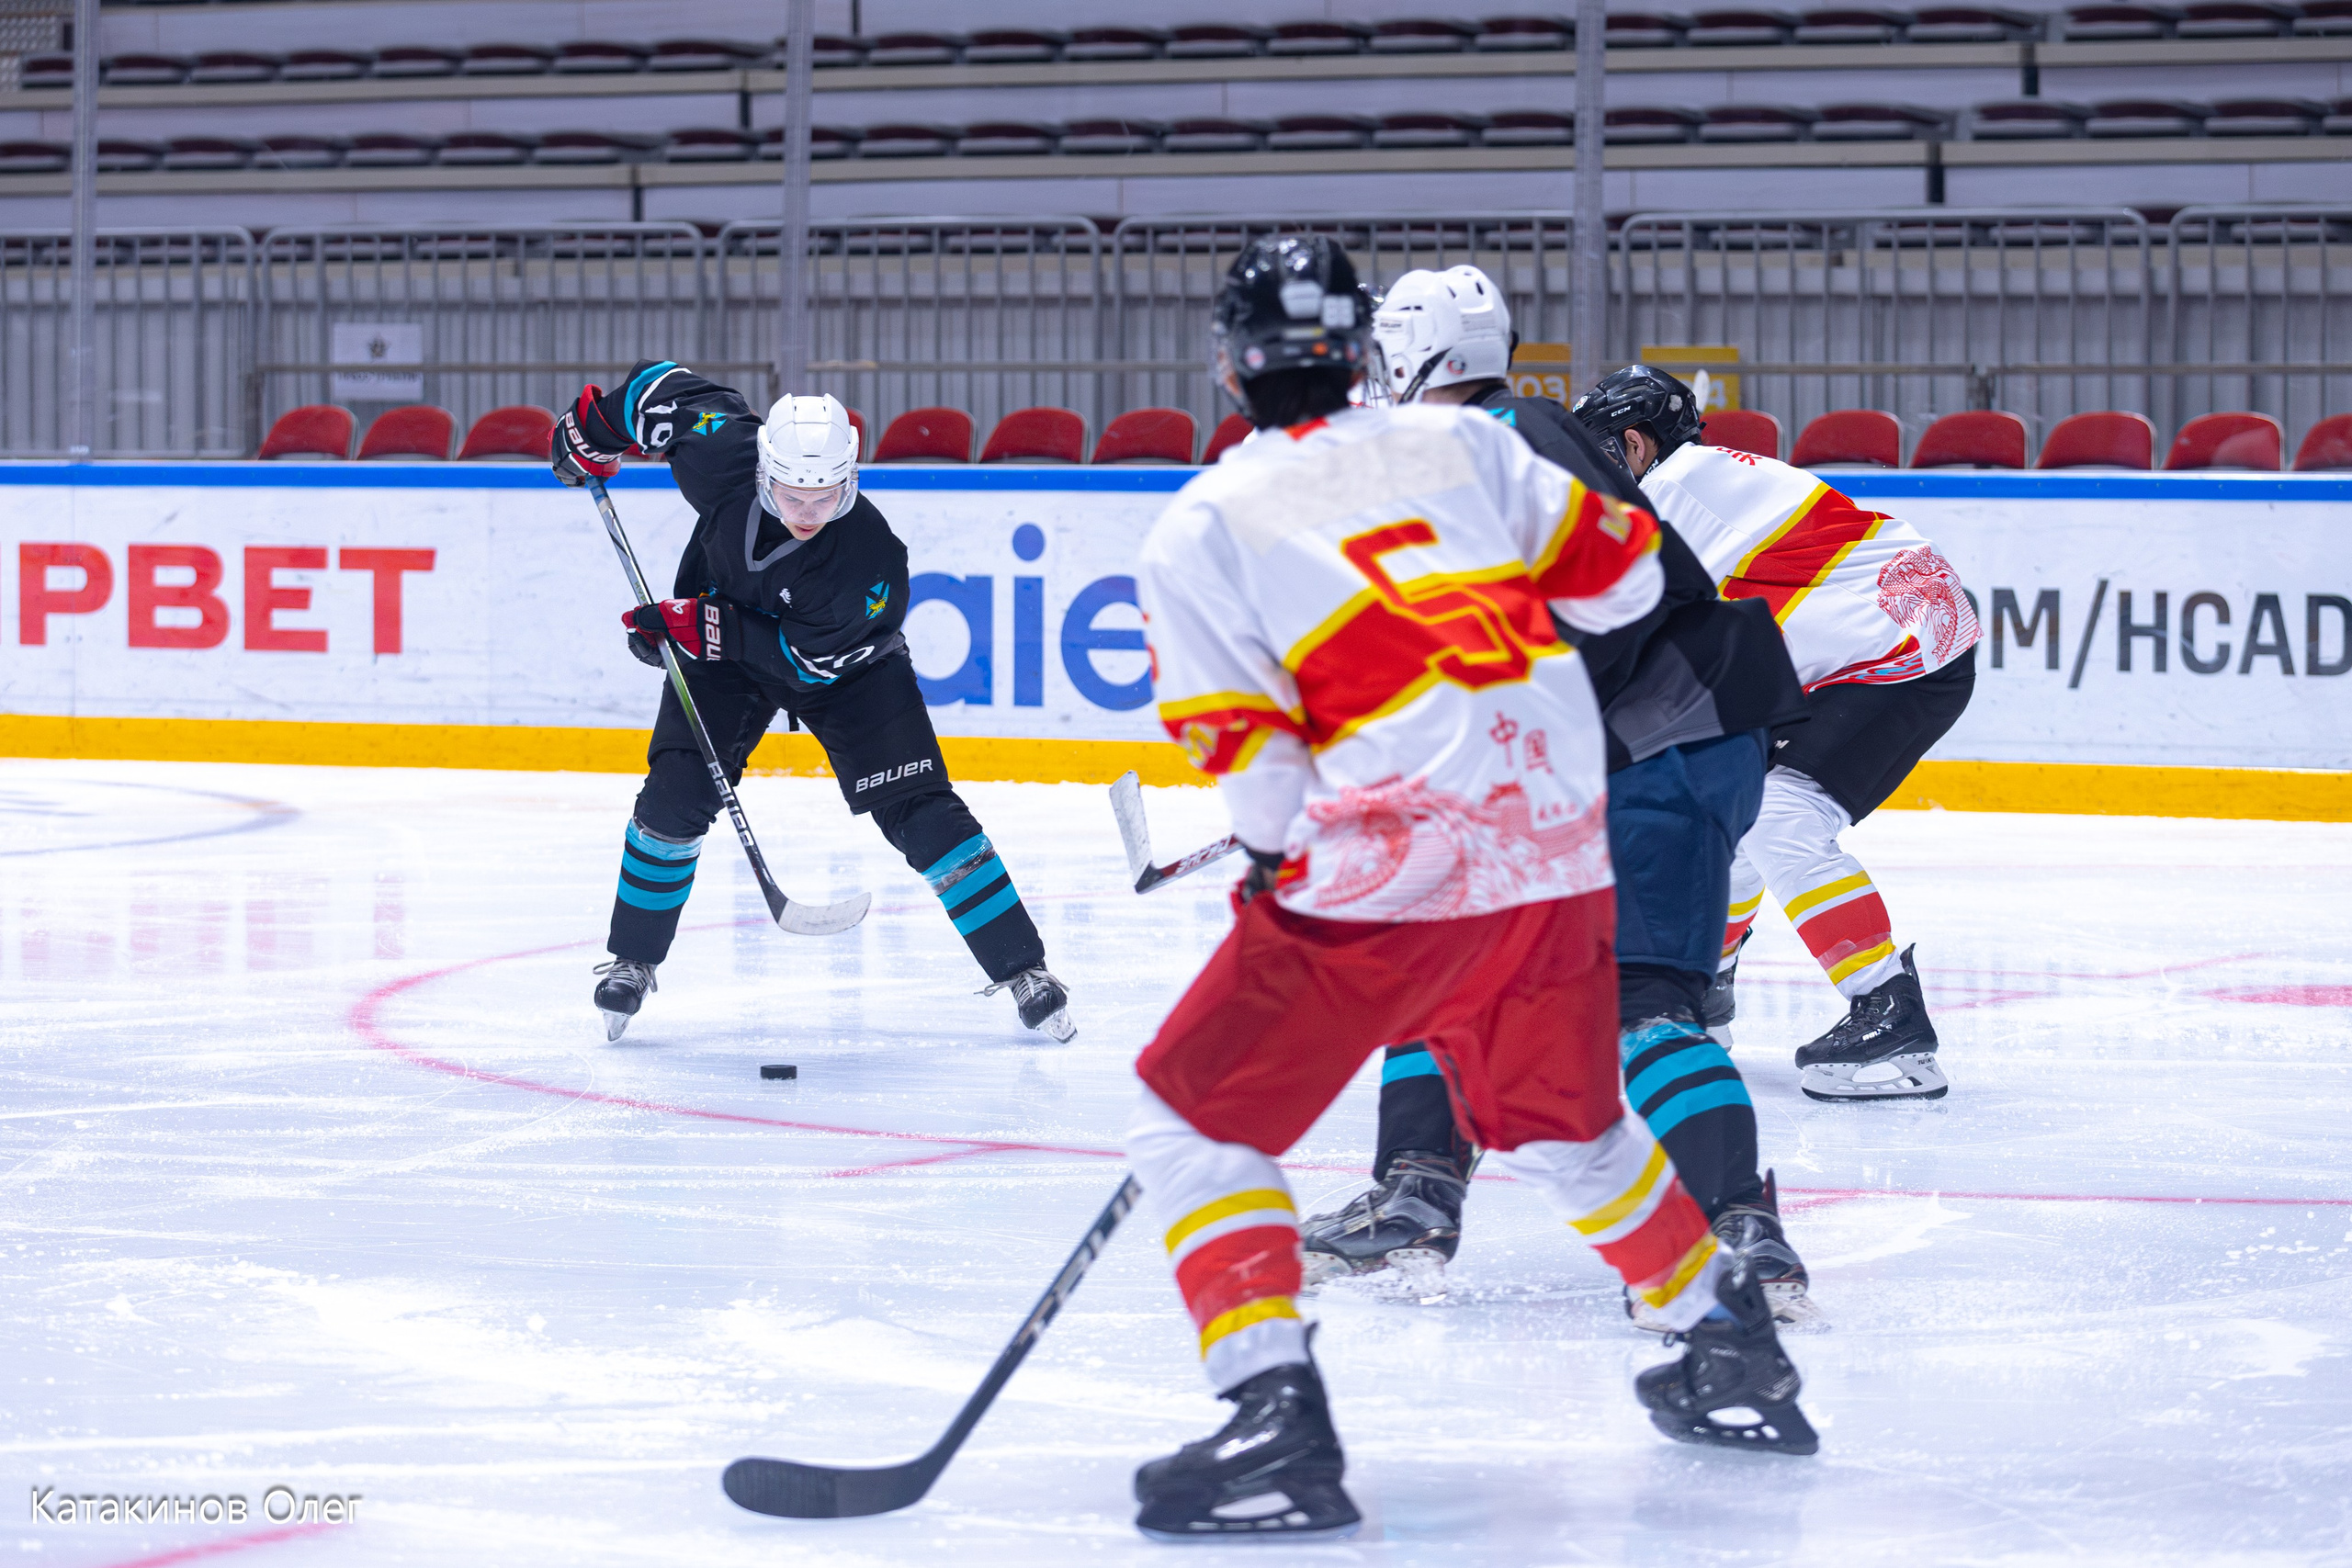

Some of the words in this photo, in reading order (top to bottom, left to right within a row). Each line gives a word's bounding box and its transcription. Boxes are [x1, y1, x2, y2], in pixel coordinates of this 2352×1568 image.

[1611, 405, 1632, 418] CCM
[0, 541, 437, 654] PBET
[704, 603, 721, 661] BAU
[901, 523, 1155, 712] aie
[1962, 579, 2352, 689] M/HCAD
[707, 761, 754, 847] BAUER
[854, 758, 933, 794] BAUER
